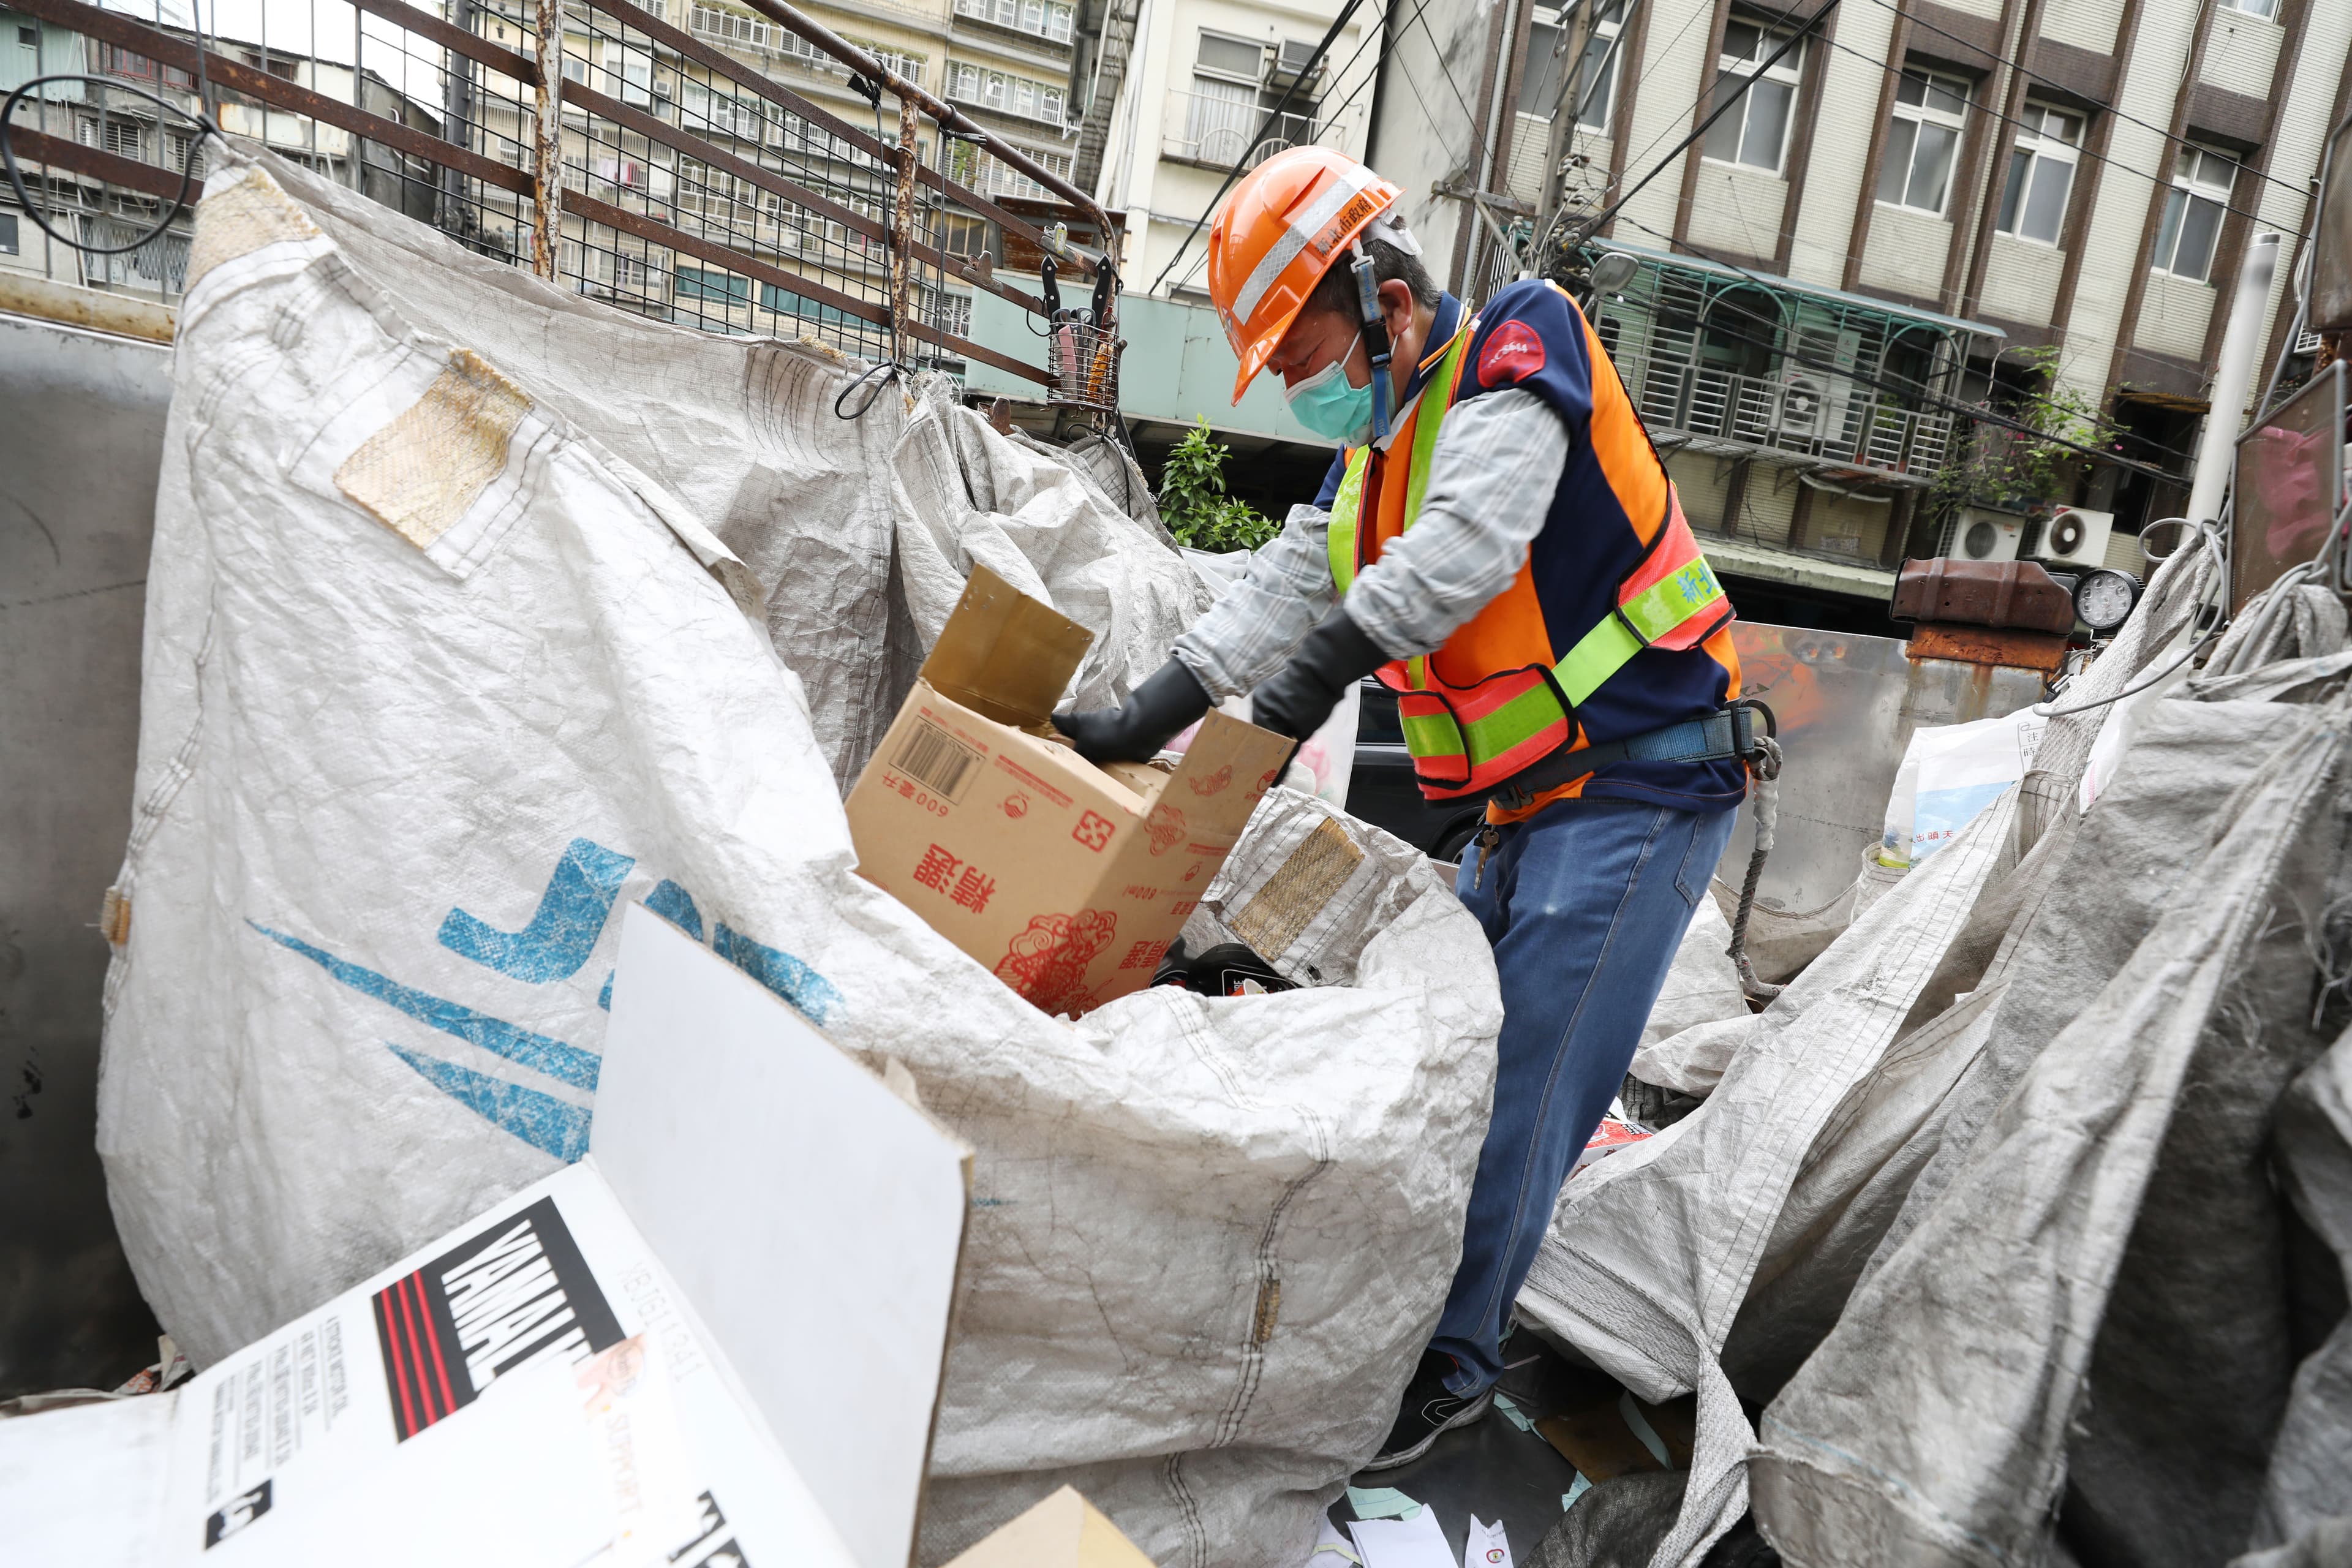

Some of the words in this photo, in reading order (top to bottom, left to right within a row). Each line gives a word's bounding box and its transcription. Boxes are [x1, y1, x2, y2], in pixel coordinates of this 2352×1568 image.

[913, 843, 996, 914] 精選
[1121, 884, 1157, 900] 600ml
[440, 1218, 592, 1392] YAMAL
